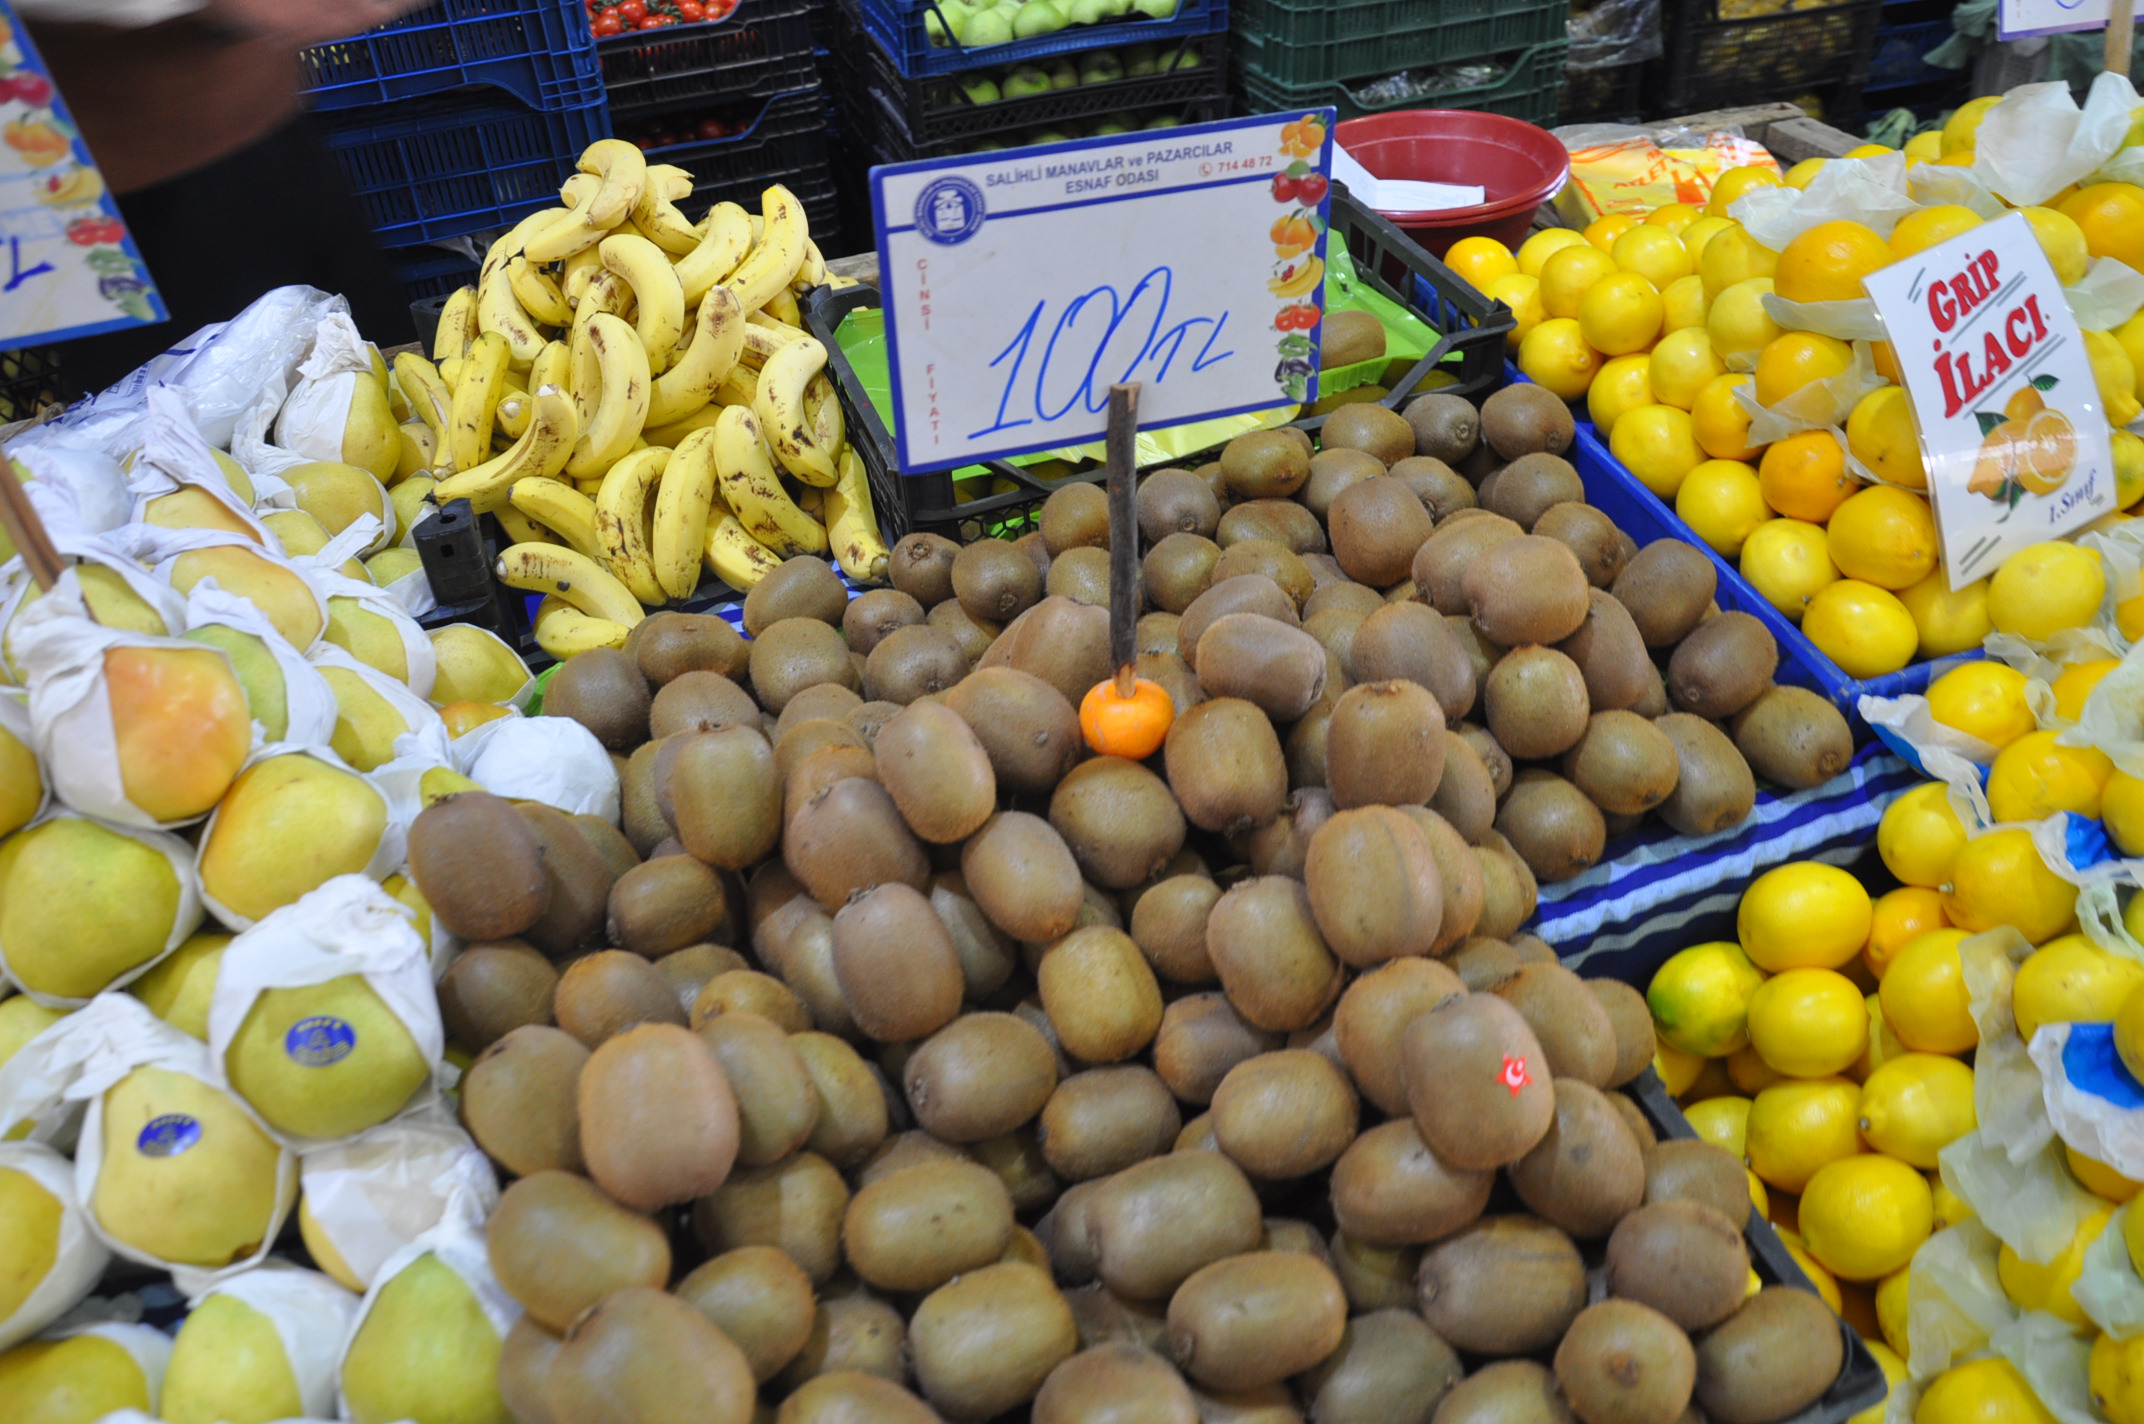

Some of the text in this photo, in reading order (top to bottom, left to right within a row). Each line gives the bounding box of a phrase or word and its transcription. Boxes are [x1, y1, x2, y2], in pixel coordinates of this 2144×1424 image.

[986, 141, 1232, 187] SALİHLİ MANAVLAR ve PAZARCILAR
[1065, 169, 1159, 195] ESNAF ODASI
[1218, 155, 1272, 173] 714 48 72
[0, 234, 56, 292] L
[1928, 249, 2001, 334] GRİP
[1933, 293, 2048, 419] İLACI
